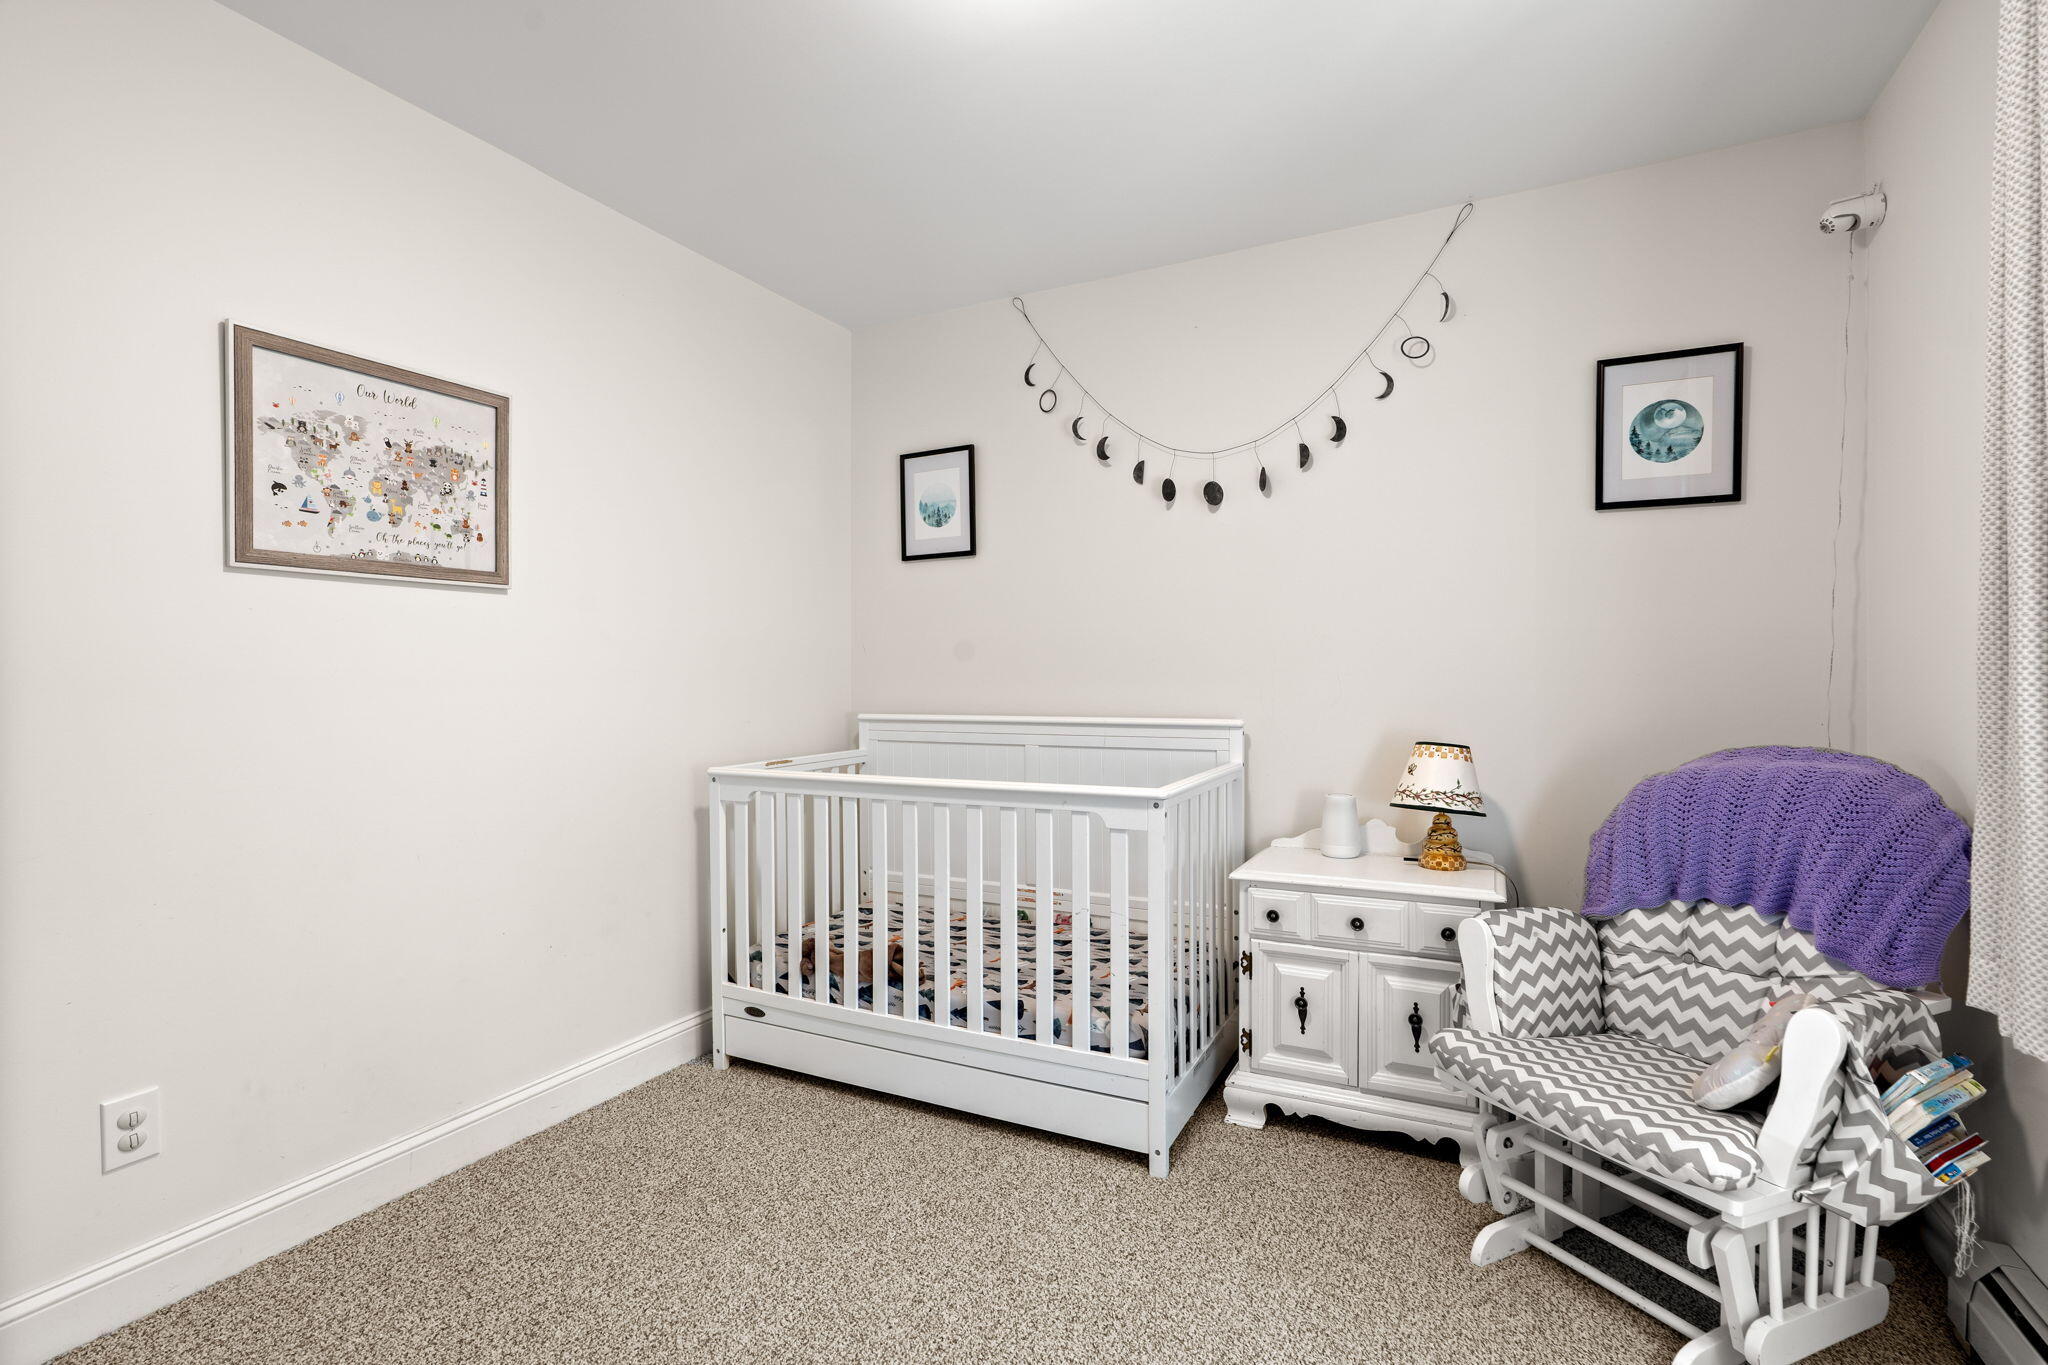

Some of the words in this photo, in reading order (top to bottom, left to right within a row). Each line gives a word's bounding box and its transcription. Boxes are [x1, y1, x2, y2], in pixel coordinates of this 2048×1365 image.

[357, 384, 378, 400] Our
[384, 390, 417, 410] World
[376, 533, 388, 543] Oh
[390, 533, 404, 544] the
[407, 537, 431, 549] places
